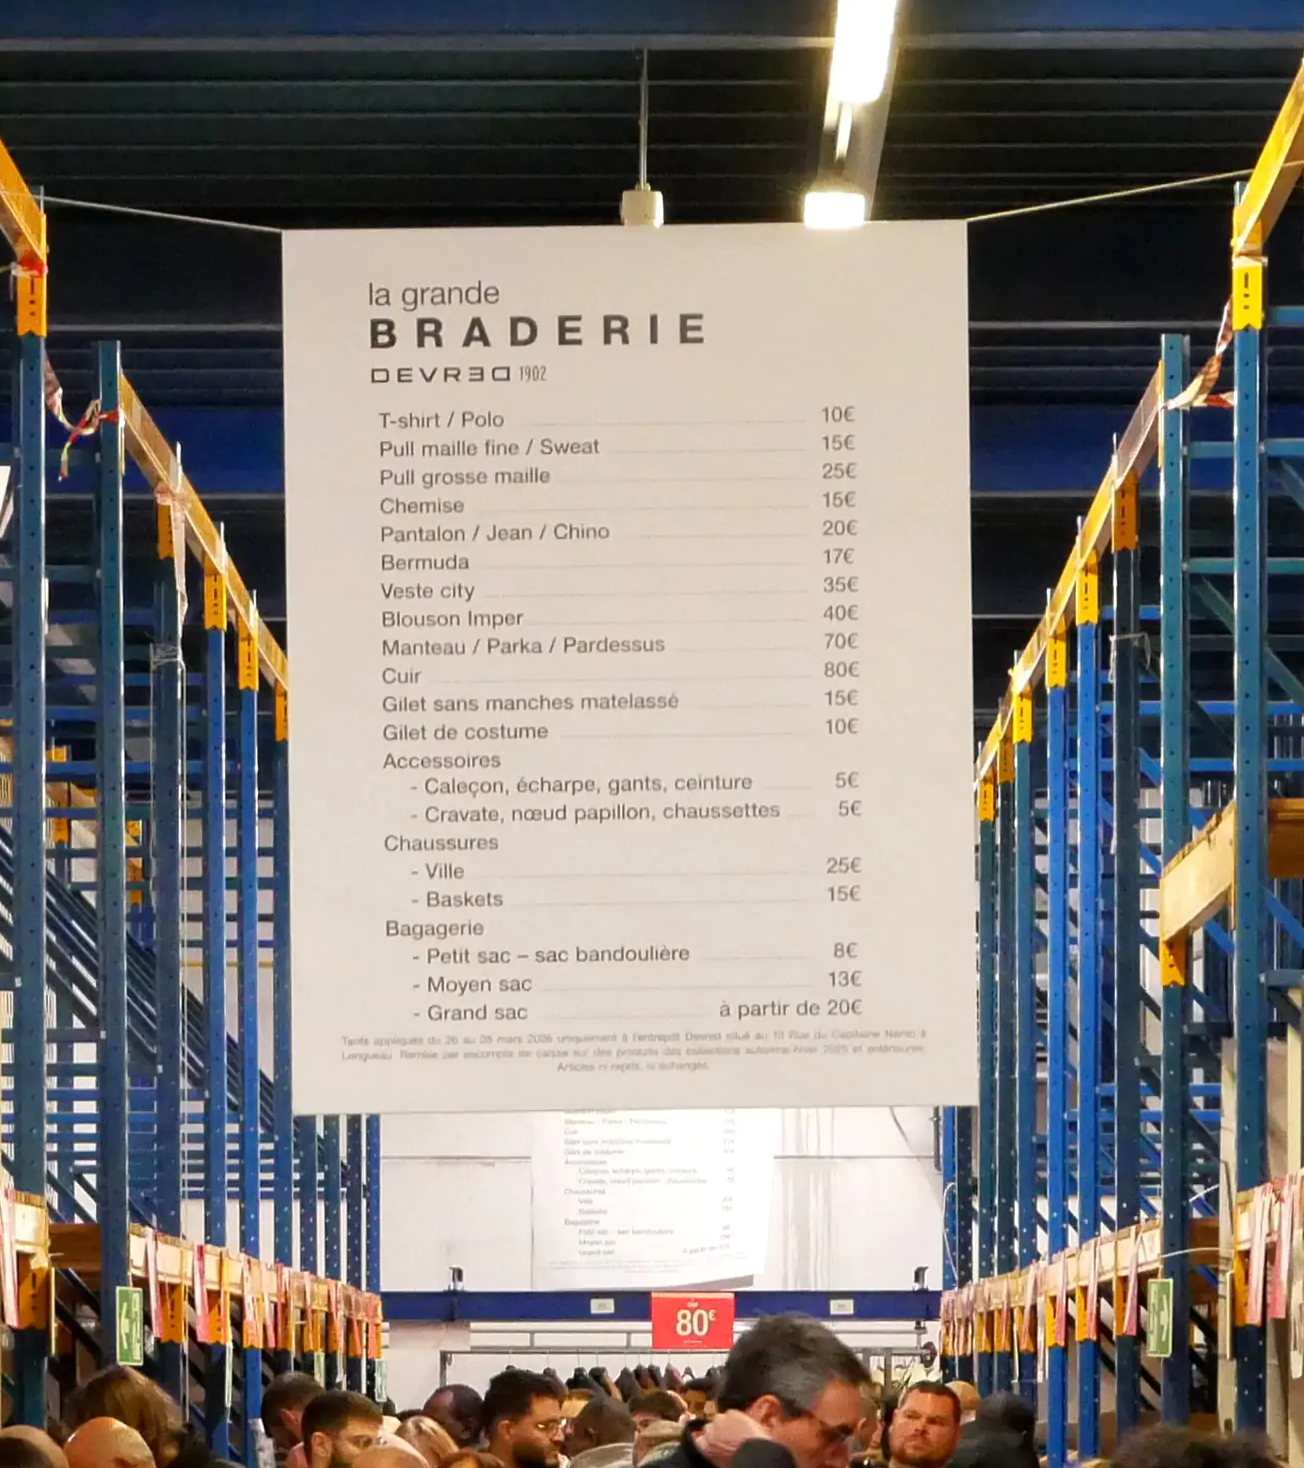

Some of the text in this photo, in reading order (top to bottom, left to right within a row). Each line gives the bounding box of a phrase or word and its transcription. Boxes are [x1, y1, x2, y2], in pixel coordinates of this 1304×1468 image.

[368, 279, 500, 313] la grande
[369, 312, 705, 350] BRADERIE
[519, 364, 547, 383] 1902
[378, 411, 441, 430] T-shirt
[461, 410, 505, 429] Polo
[821, 405, 856, 424] 10€
[379, 440, 415, 458] Pull
[421, 439, 478, 458] maille
[484, 438, 520, 457] fine
[539, 437, 600, 456] Sweat
[821, 434, 855, 452] 15€
[379, 462, 857, 490] Pull grosse maille 25€
[379, 490, 856, 515] Chemise 15€
[380, 524, 466, 544] Pantalon
[485, 523, 533, 542] Jean
[553, 522, 610, 541] Chino
[822, 519, 858, 537] 20€
[381, 547, 855, 572] Bermuda 17€
[380, 575, 859, 603] Veste city 35€
[381, 604, 859, 631] Blouson Imper 40€
[382, 639, 466, 657] Manteau
[487, 637, 544, 655] Parka
[563, 635, 666, 654] Pardessus
[823, 632, 859, 650] 70€
[381, 660, 860, 685] Cuir 80€
[382, 688, 859, 714] Gilet sans manches matelassé 15€
[382, 717, 859, 742] Gilet de costume 10€
[382, 752, 502, 770] Accessoires
[424, 776, 510, 799] Caleçon,
[516, 775, 601, 797] écharpe,
[607, 775, 668, 797] gants,
[674, 774, 753, 792] ceinture
[835, 771, 859, 789] 5€
[424, 805, 505, 825] Cravate,
[511, 803, 567, 822] nœud
[574, 802, 656, 825] papillon,
[662, 802, 781, 820] chaussettes
[838, 799, 862, 818] 5€
[383, 834, 499, 852] Chaussures
[424, 862, 465, 880] Ville
[826, 856, 862, 875] 25€
[426, 890, 504, 908] Baskets
[827, 884, 861, 903] 15€
[385, 919, 485, 942] Bagagerie
[427, 947, 471, 965] Petit
[477, 950, 511, 965] sac
[534, 949, 569, 964] sac
[575, 944, 690, 963] bandoulière
[833, 941, 858, 960] 8€
[427, 975, 492, 997] Moyen
[498, 978, 533, 993] sac
[828, 970, 862, 988] 13€
[427, 1003, 488, 1022] Grand
[494, 1006, 528, 1021] sac
[719, 999, 732, 1018] à
[737, 1000, 791, 1021] partir
[795, 999, 821, 1017] de
[827, 998, 863, 1016] 20€
[675, 1308, 717, 1337] 80€
